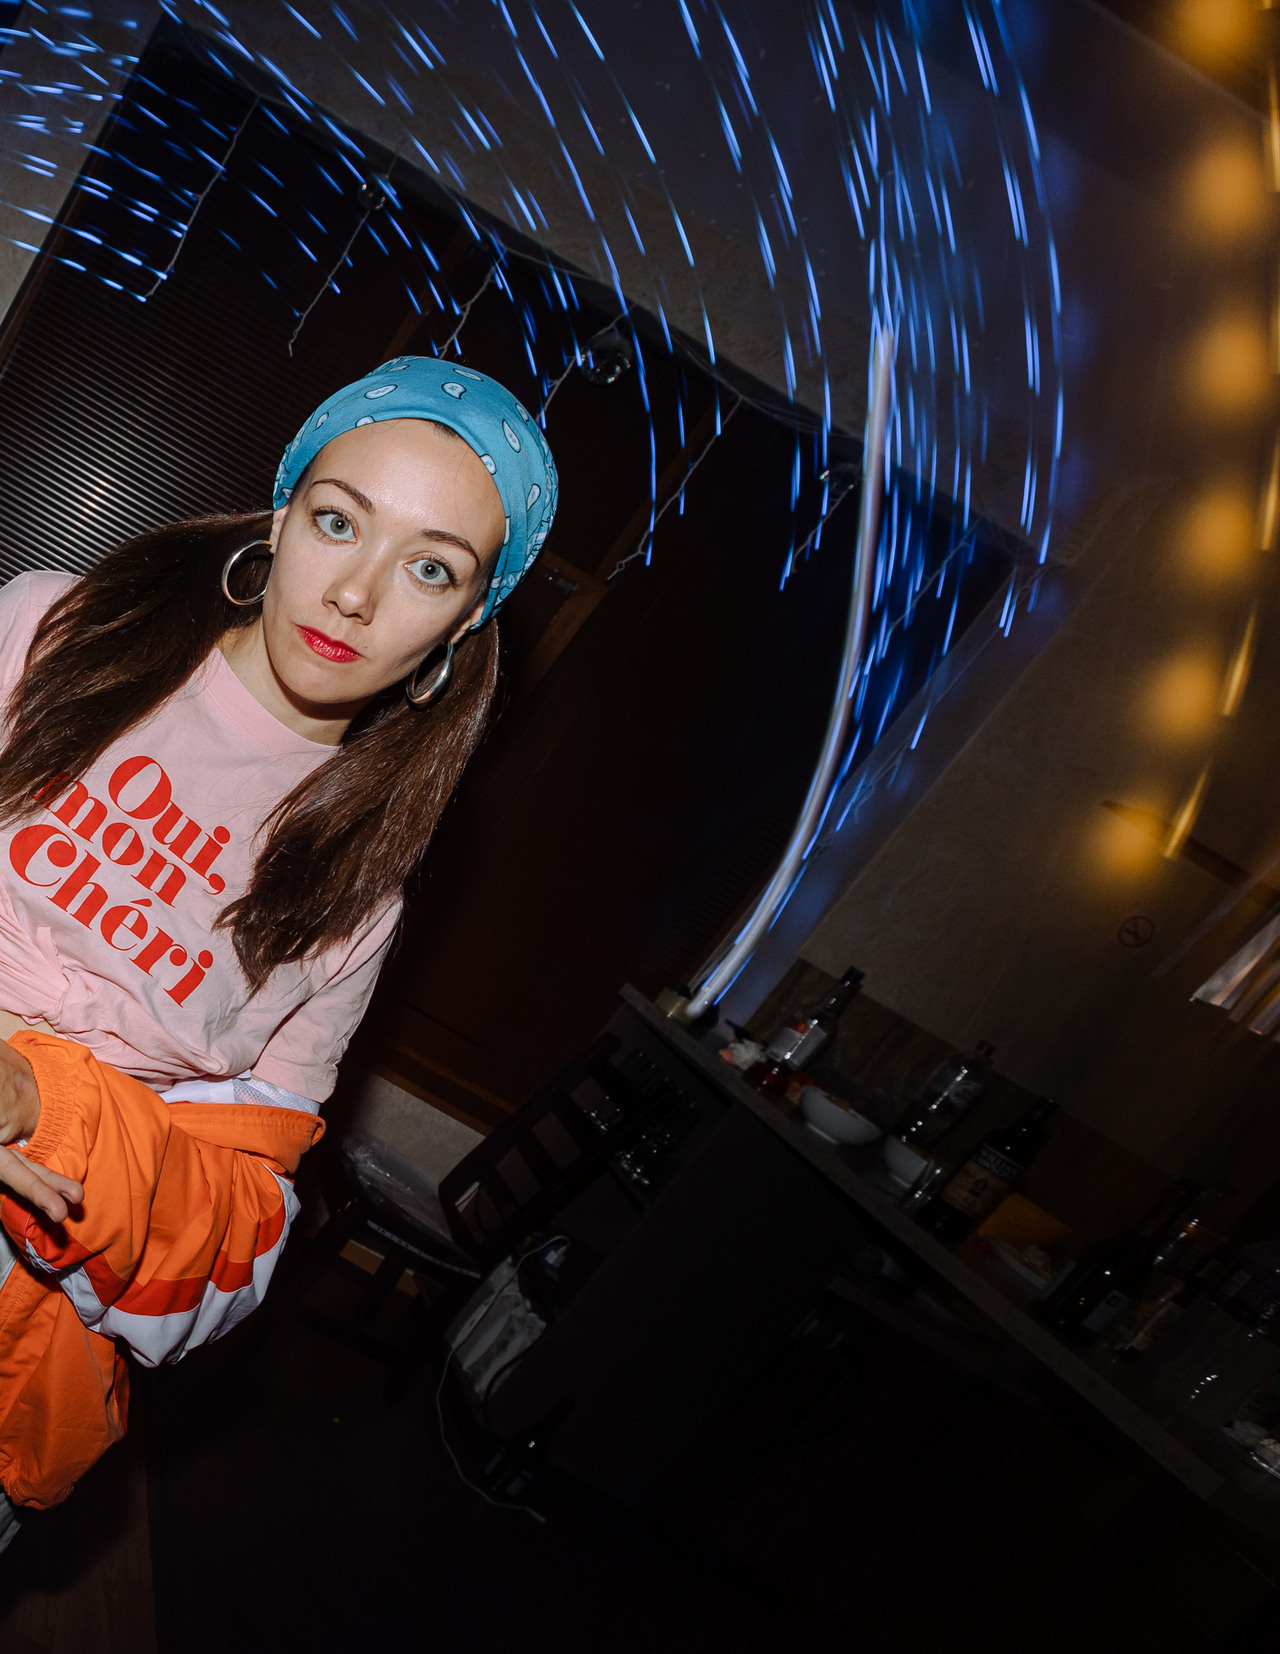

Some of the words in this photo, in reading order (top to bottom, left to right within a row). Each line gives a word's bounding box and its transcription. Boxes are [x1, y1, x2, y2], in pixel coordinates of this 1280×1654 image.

[33, 771, 187, 908] mon
[108, 755, 231, 895] Oui,
[9, 824, 214, 1008] Chéri
